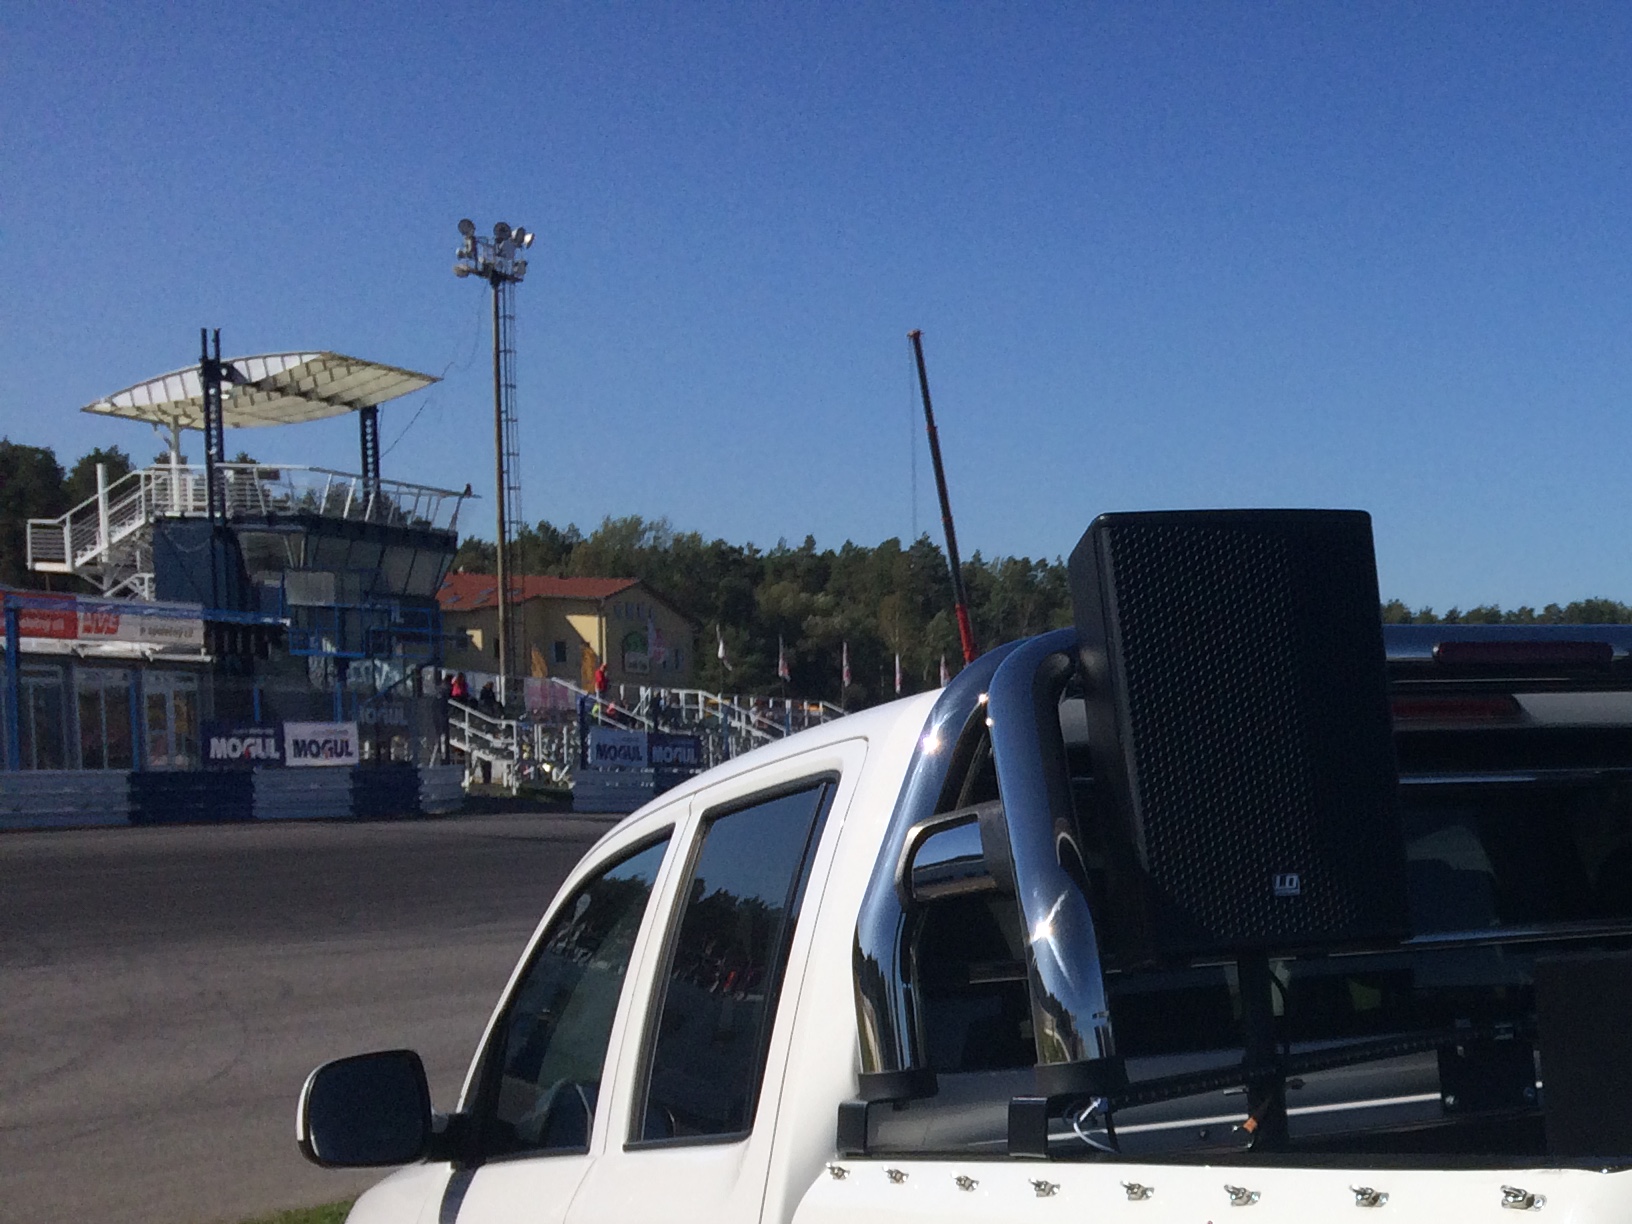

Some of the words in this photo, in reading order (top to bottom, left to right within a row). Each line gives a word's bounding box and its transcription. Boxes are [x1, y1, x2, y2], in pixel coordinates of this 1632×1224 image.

[209, 736, 280, 759] MOGUL
[292, 738, 353, 759] MOGUL
[596, 742, 642, 762] MOGUL
[652, 745, 698, 764] MOGUL
